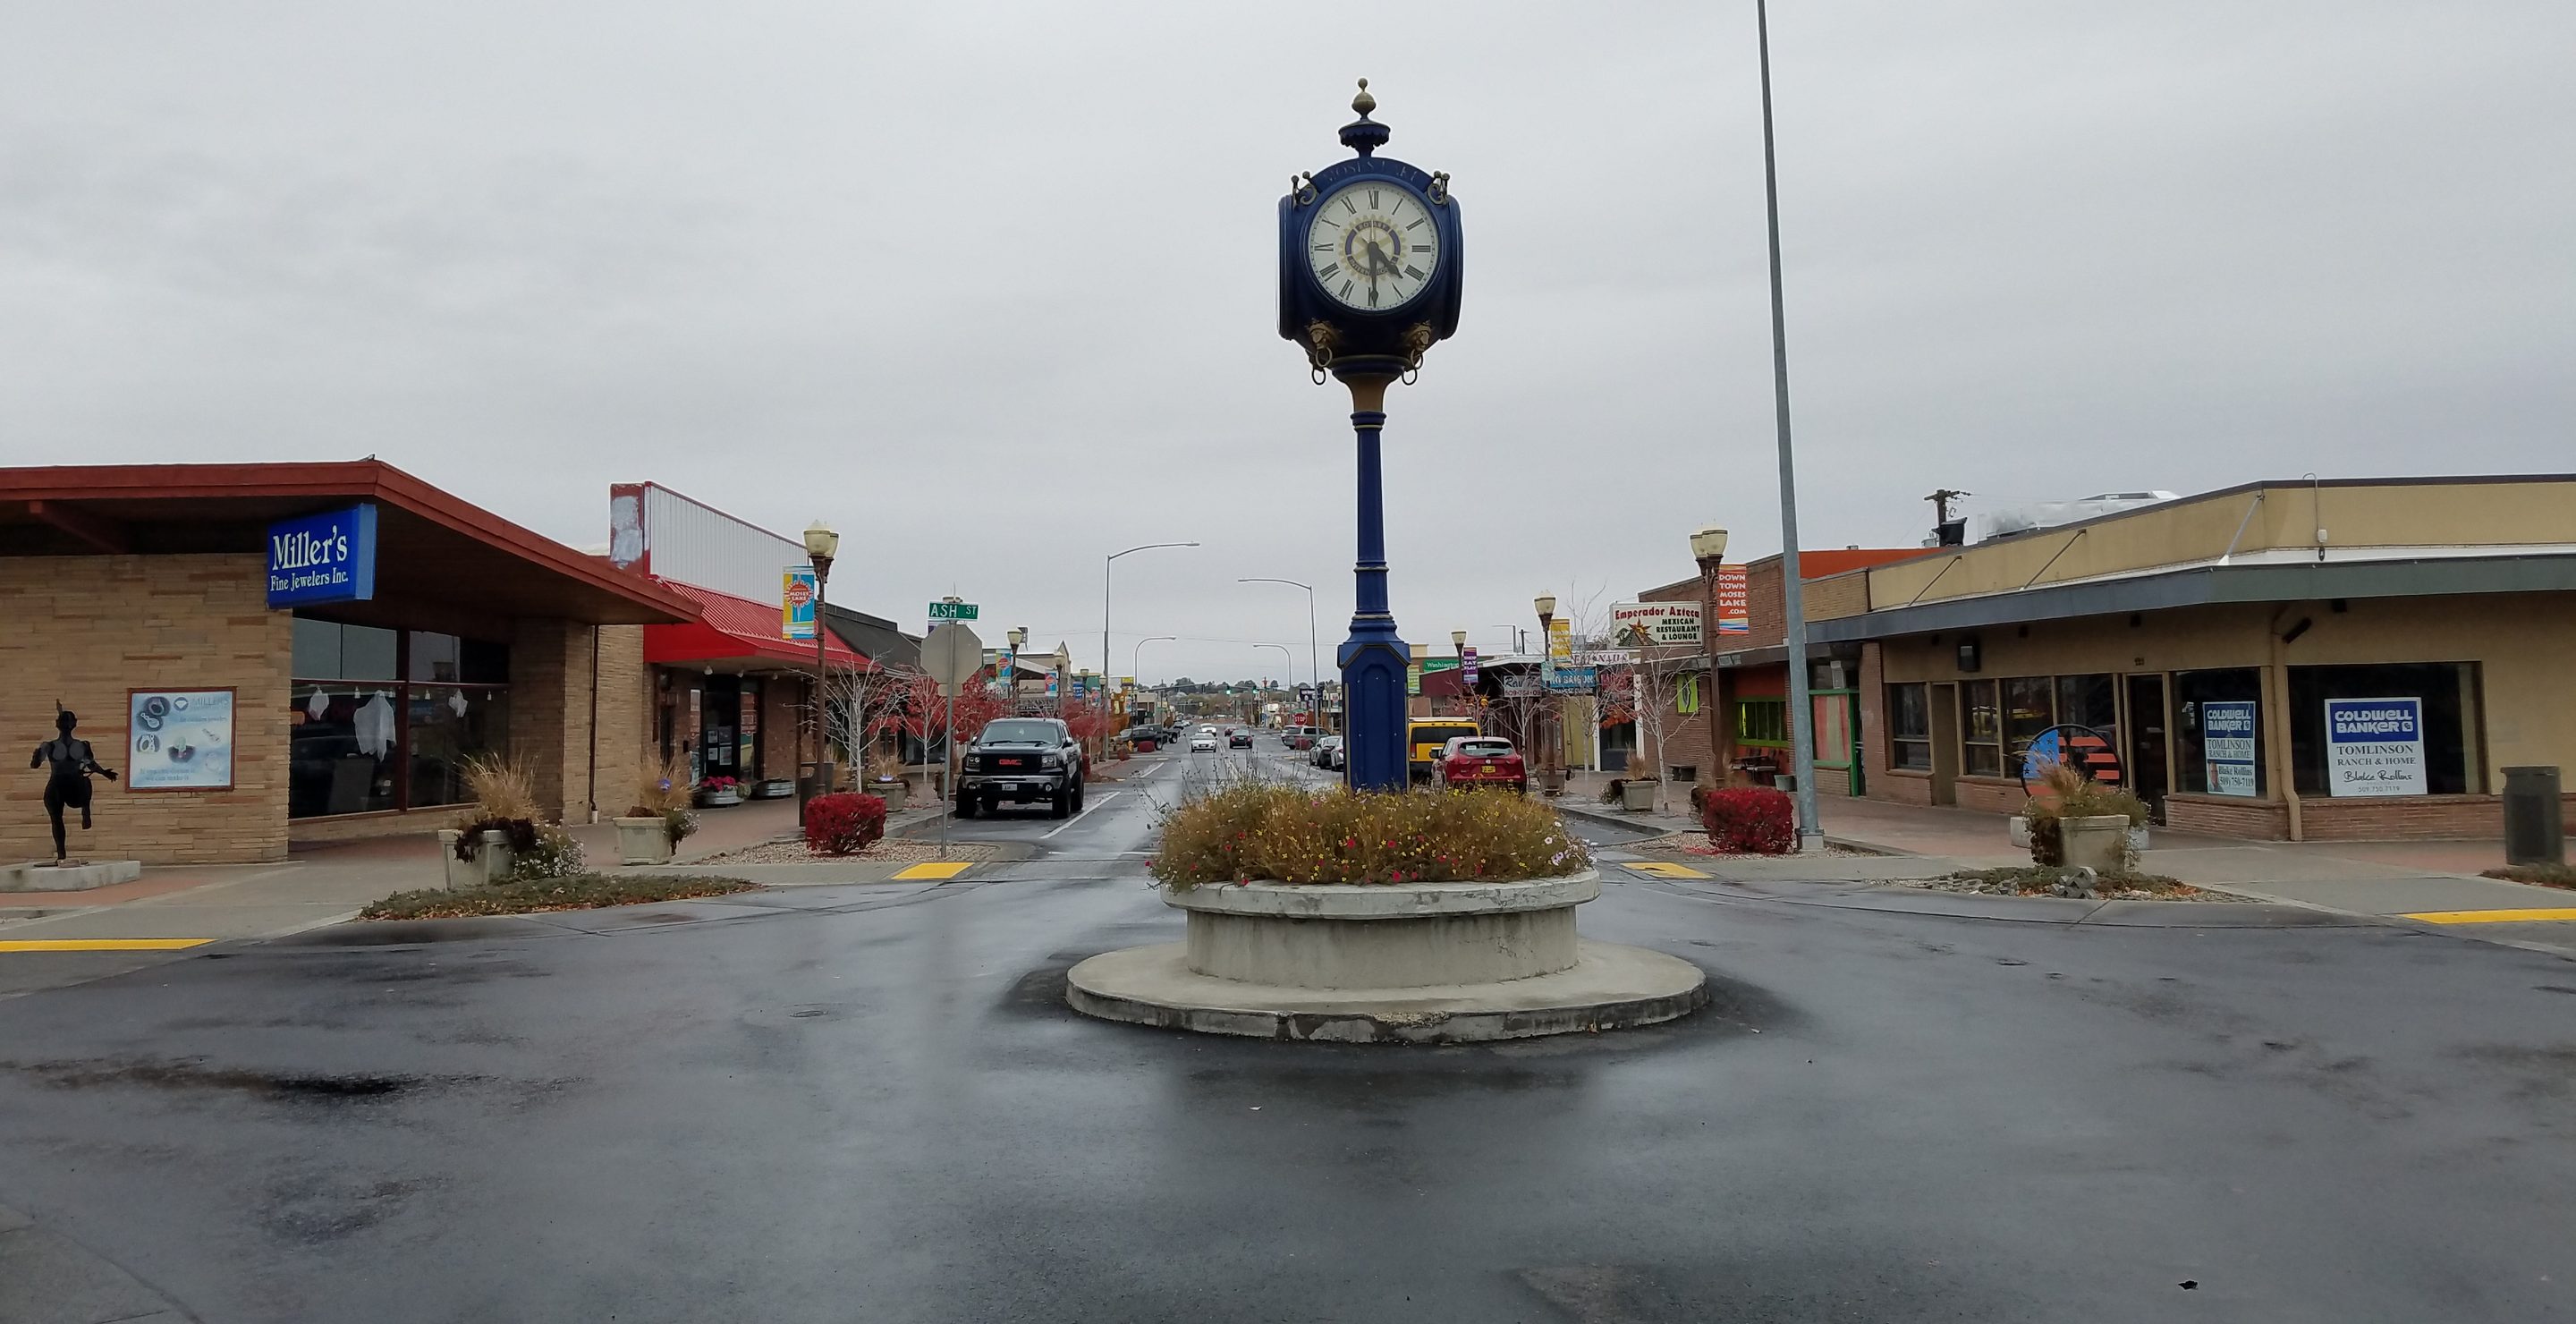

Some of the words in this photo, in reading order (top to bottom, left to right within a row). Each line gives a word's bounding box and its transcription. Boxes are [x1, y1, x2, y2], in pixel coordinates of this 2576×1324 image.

[272, 524, 348, 571] Miller's
[270, 575, 289, 591] Fine
[290, 571, 330, 591] Jewelers
[332, 567, 349, 584] Inc.
[930, 604, 957, 617] ASH
[966, 606, 977, 615] ST
[1615, 607, 1665, 620] Emperador
[1669, 607, 1699, 618] Azteca
[2207, 709, 2251, 720] COLDWELL
[2334, 709, 2413, 722] COLDWELL
[2208, 720, 2241, 732] BANKER
[2336, 721, 2400, 734] BANKER
[2207, 739, 2251, 750] TOMLINSON
[2336, 744, 2414, 755] TOMLINSON
[2208, 751, 2227, 759] RANCH
[2234, 751, 2250, 759] HOME
[2337, 758, 2372, 766] RANCH
[2385, 757, 2416, 765] HOME
[2219, 766, 2233, 775] Blake
[2234, 766, 2252, 776] Rollins
[2343, 770, 2377, 783] Blake
[2377, 769, 2412, 781] Rollins
